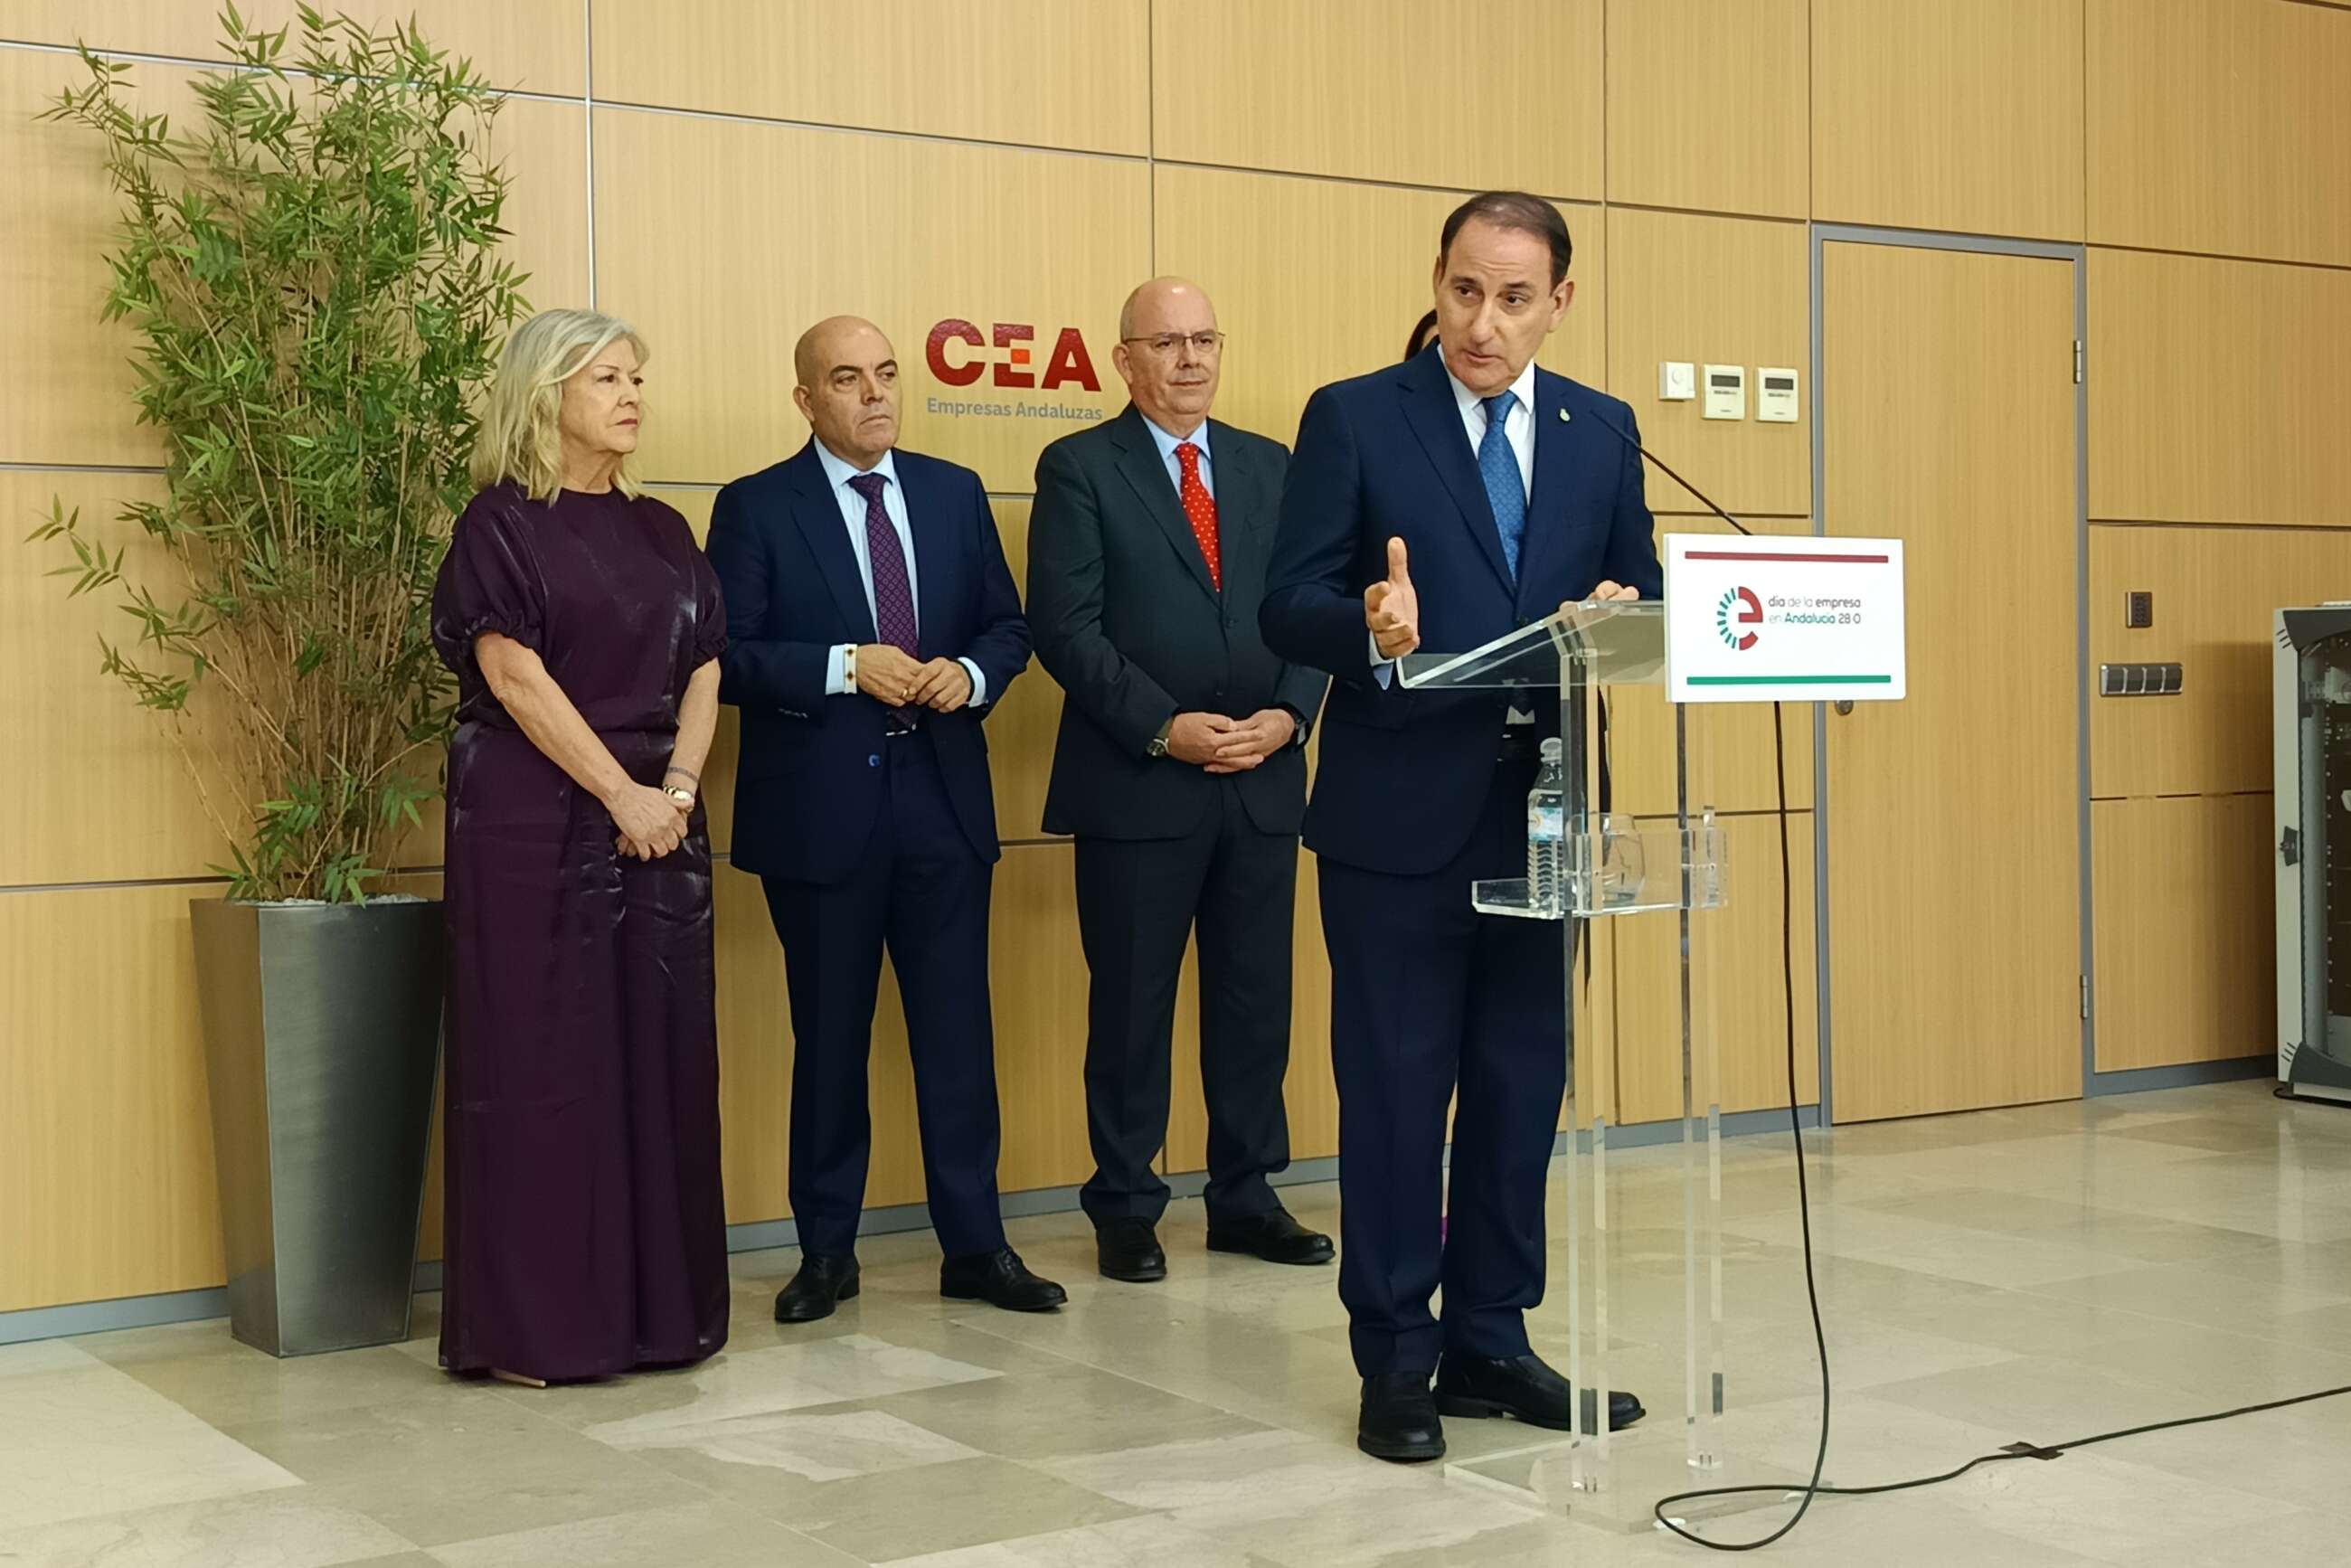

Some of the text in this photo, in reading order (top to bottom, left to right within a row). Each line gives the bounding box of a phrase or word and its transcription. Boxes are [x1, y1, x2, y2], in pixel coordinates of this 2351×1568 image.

[926, 318, 1101, 392] CEA
[927, 398, 1102, 420] Empresas Andaluzas
[1788, 597, 1801, 608] de
[1804, 596, 1813, 608] la
[1815, 599, 1861, 610] empresa
[1769, 615, 1781, 624] en
